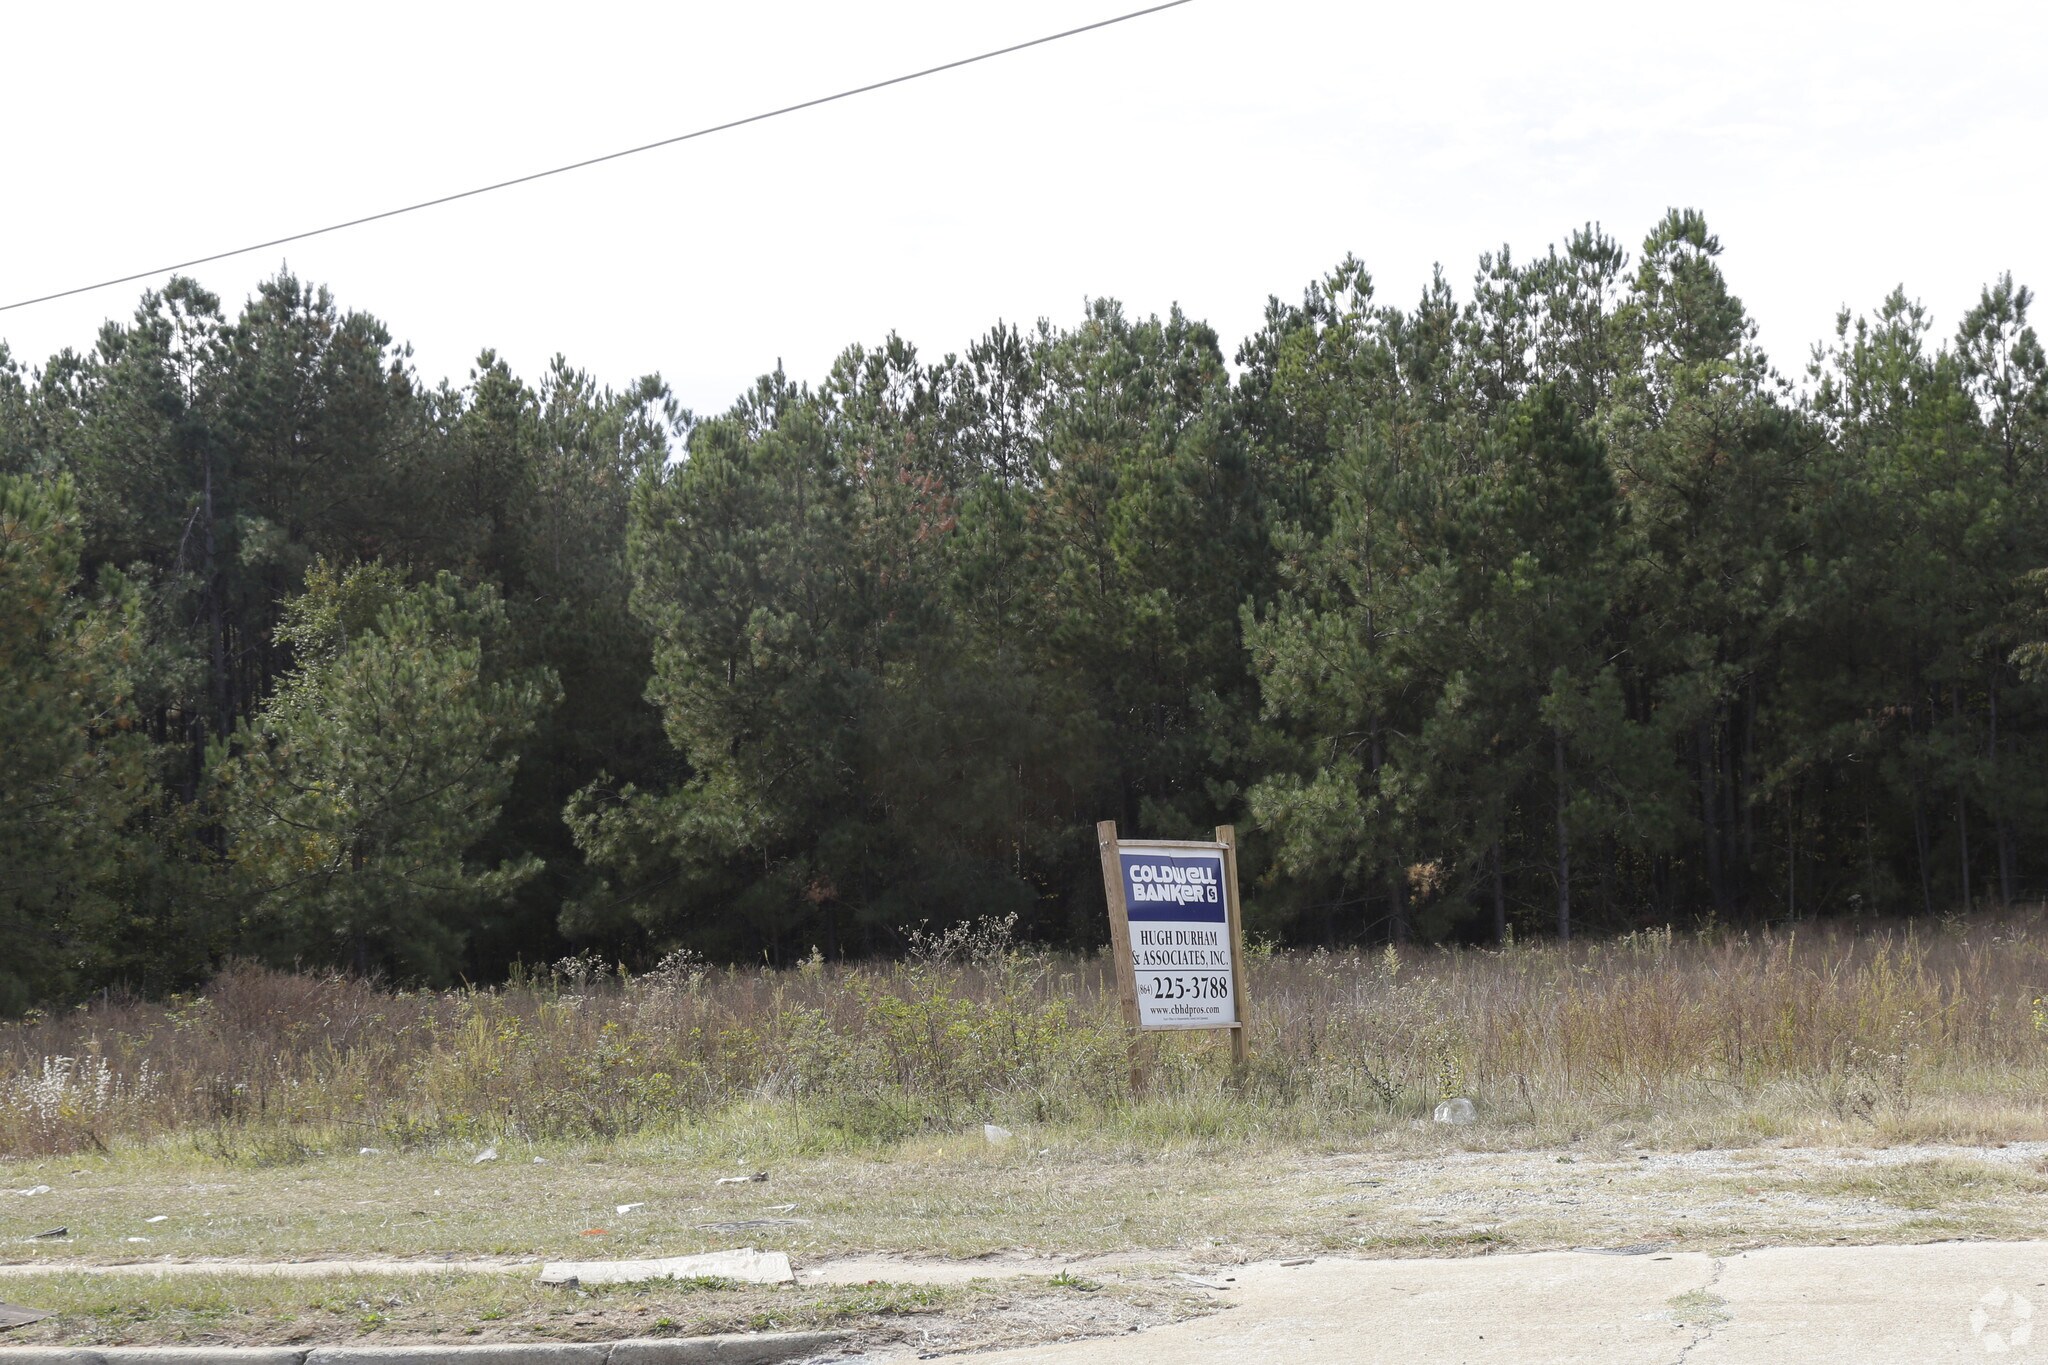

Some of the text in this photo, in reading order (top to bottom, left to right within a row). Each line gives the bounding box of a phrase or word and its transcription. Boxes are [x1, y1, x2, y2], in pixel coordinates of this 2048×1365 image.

[1129, 864, 1217, 885] COLDWELL
[1132, 883, 1205, 906] BANKER
[1140, 930, 1218, 946] HUGH DURHAM
[1132, 949, 1229, 968] & ASSOCIATES, INC.
[1137, 976, 1228, 999] (864) 225-3788
[1150, 1003, 1220, 1017] www.cbhdpros.com
